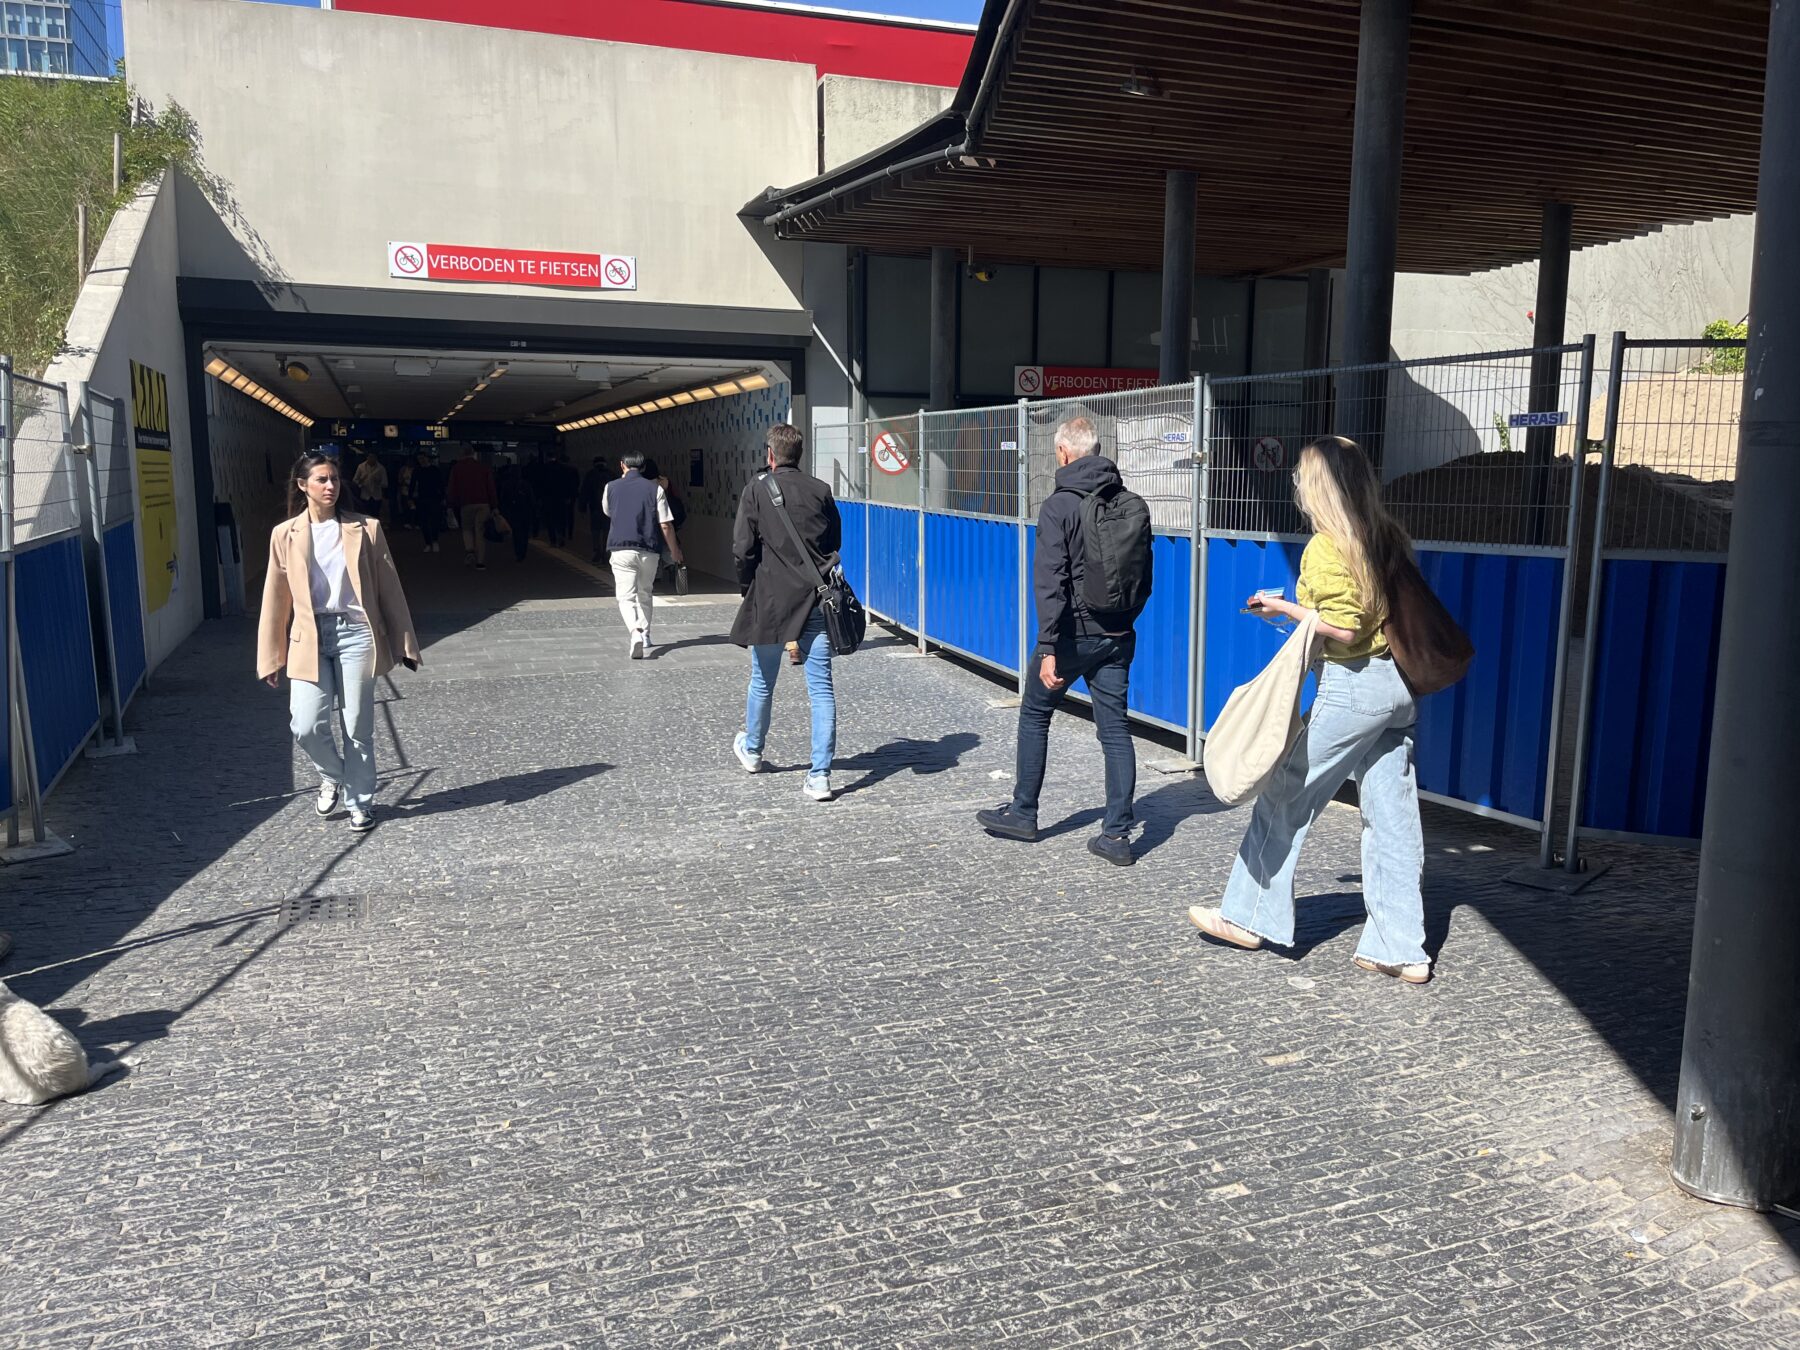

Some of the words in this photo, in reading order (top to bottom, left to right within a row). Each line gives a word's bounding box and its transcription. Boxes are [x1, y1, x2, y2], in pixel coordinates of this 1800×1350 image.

[428, 254, 515, 273] VERBODEN
[517, 259, 536, 275] TE
[540, 261, 599, 278] FIETSEN
[1044, 374, 1108, 390] VERBODEN
[1111, 378, 1123, 390] TE
